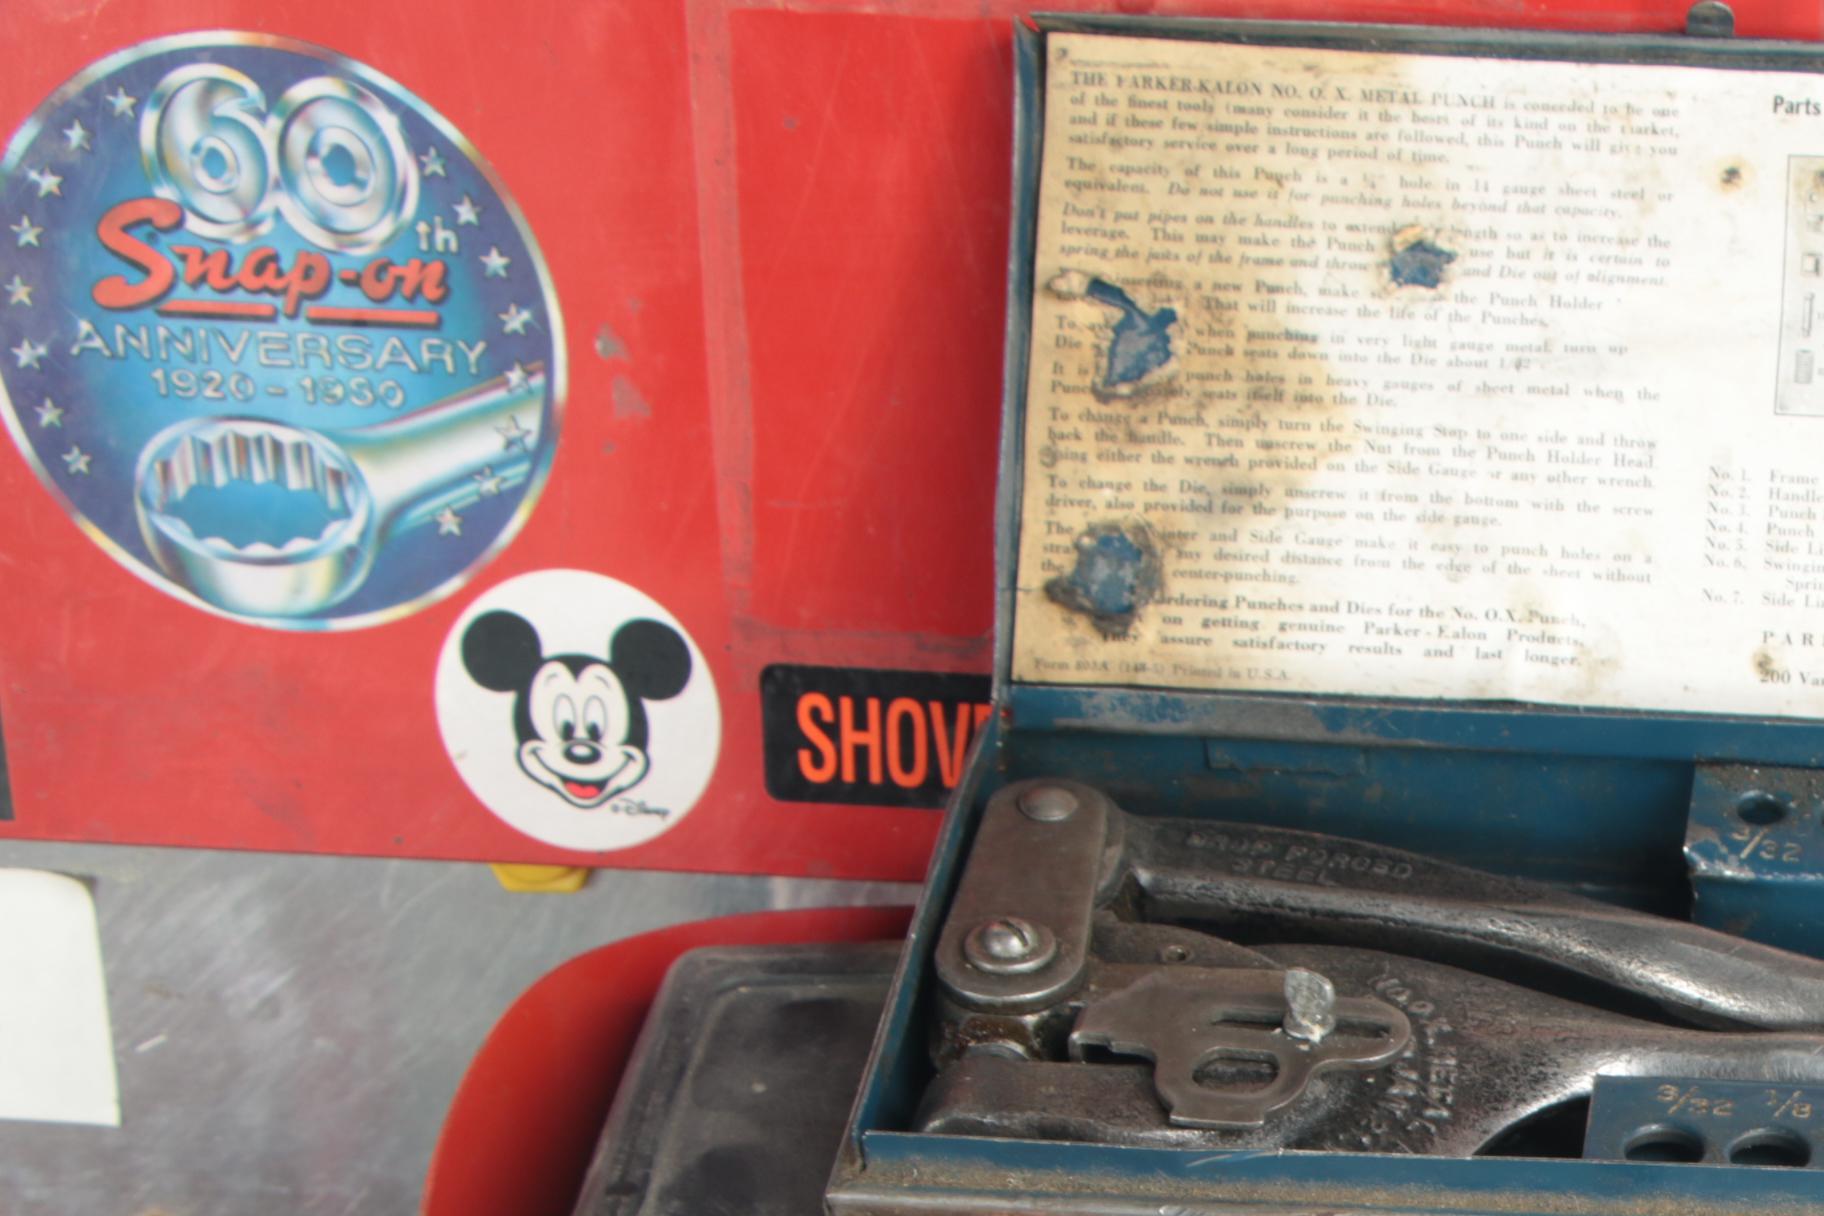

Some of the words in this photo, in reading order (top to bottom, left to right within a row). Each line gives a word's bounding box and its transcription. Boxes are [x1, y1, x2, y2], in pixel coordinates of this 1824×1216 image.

[1771, 95, 1822, 116] Parts
[139, 61, 420, 256] 60
[416, 219, 459, 253] th
[92, 197, 450, 322] Snap-on
[71, 320, 487, 376] ANNIVERSARY
[151, 366, 255, 402] 1920
[299, 376, 406, 409] 1980
[1757, 667, 1792, 684] 200
[1656, 1084, 1735, 1117] 3/32
[1764, 1088, 1813, 1121] 1/8
